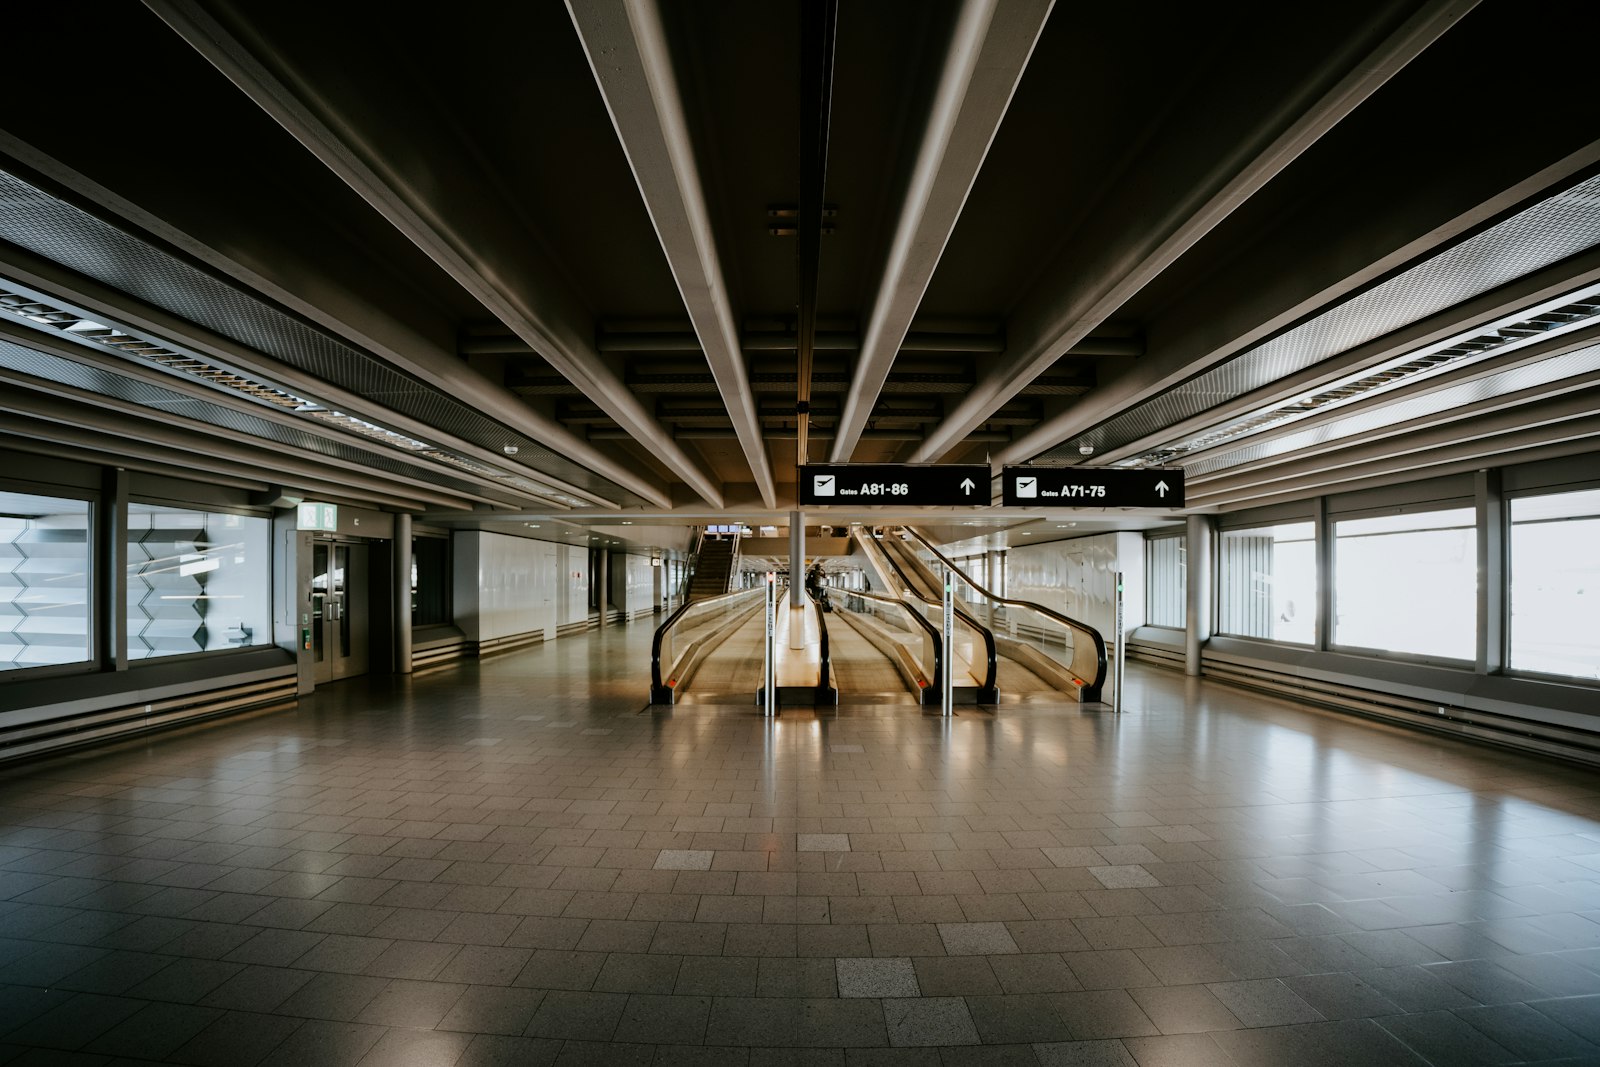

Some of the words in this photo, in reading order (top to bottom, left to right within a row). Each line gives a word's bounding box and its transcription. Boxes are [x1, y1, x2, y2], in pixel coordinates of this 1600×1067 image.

[839, 488, 858, 496] Gates
[860, 483, 909, 496] A81-86
[1061, 485, 1106, 497] A71-75
